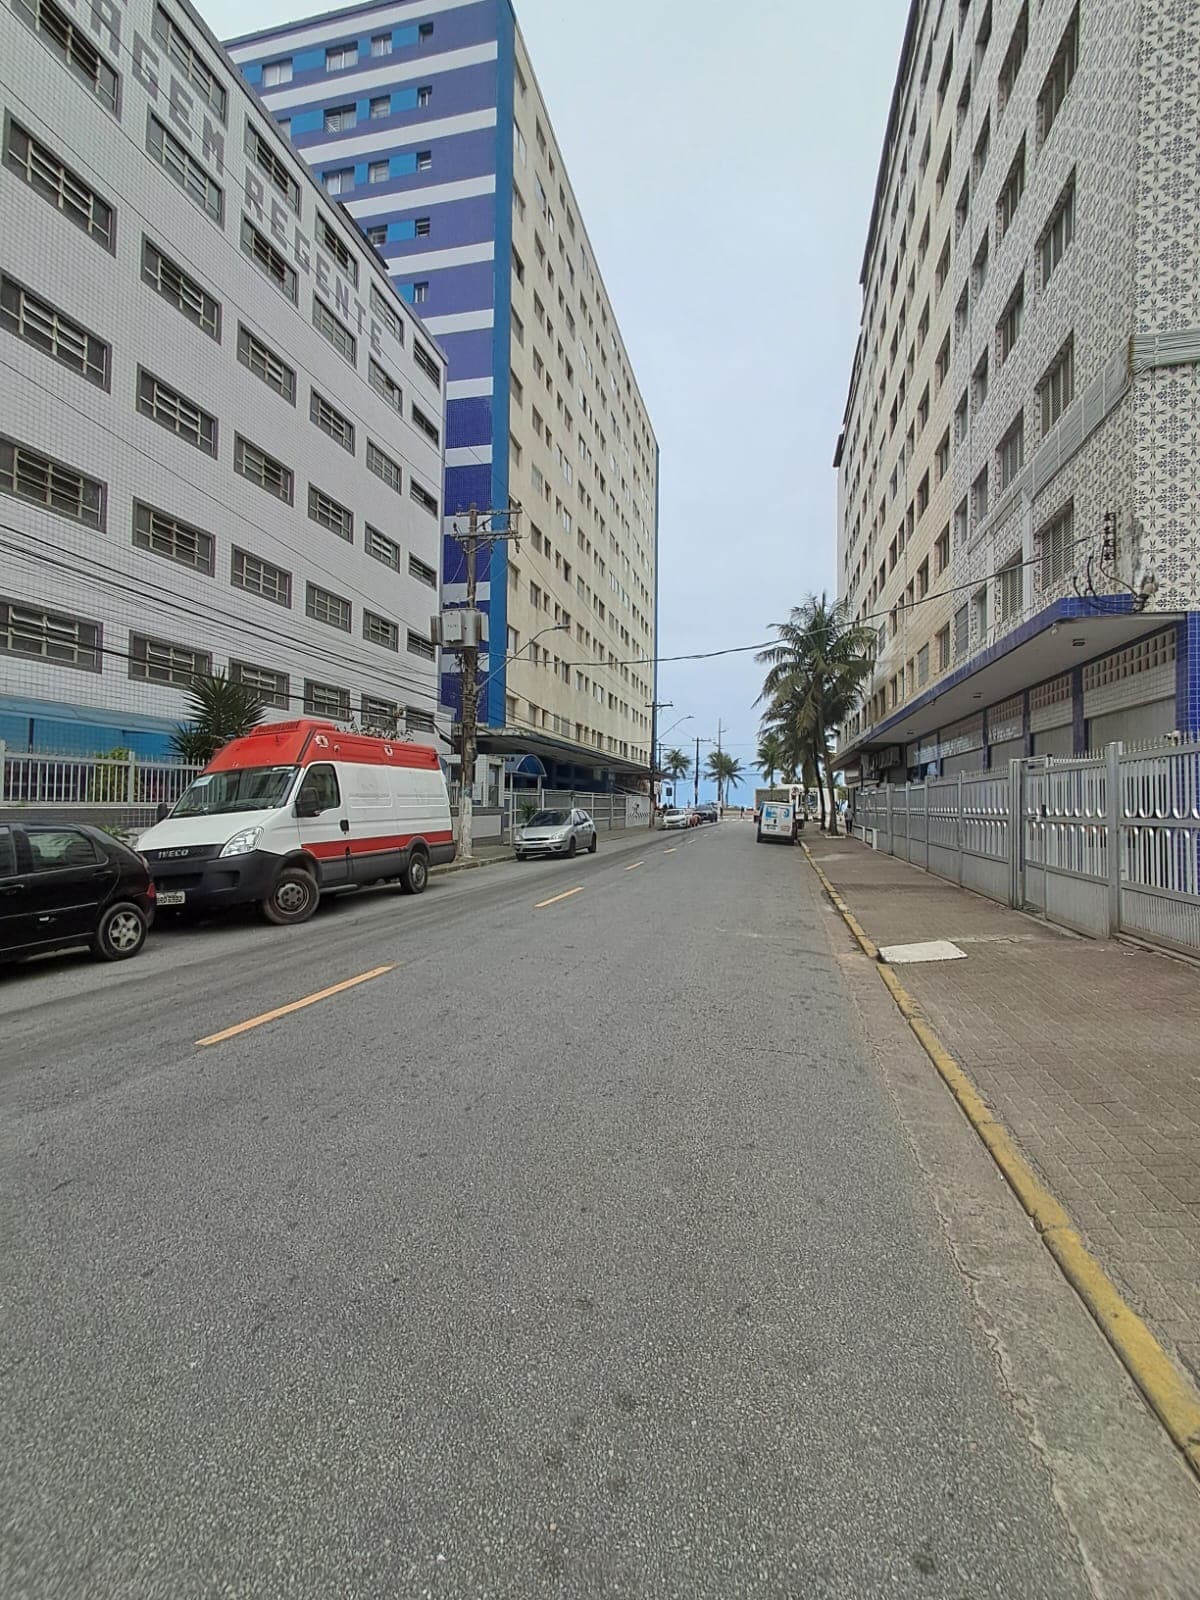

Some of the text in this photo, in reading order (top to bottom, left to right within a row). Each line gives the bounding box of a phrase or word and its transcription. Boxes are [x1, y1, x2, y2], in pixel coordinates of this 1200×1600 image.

[64, 0, 383, 358] AGEM REGENTE
[158, 849, 189, 859] IVECO
